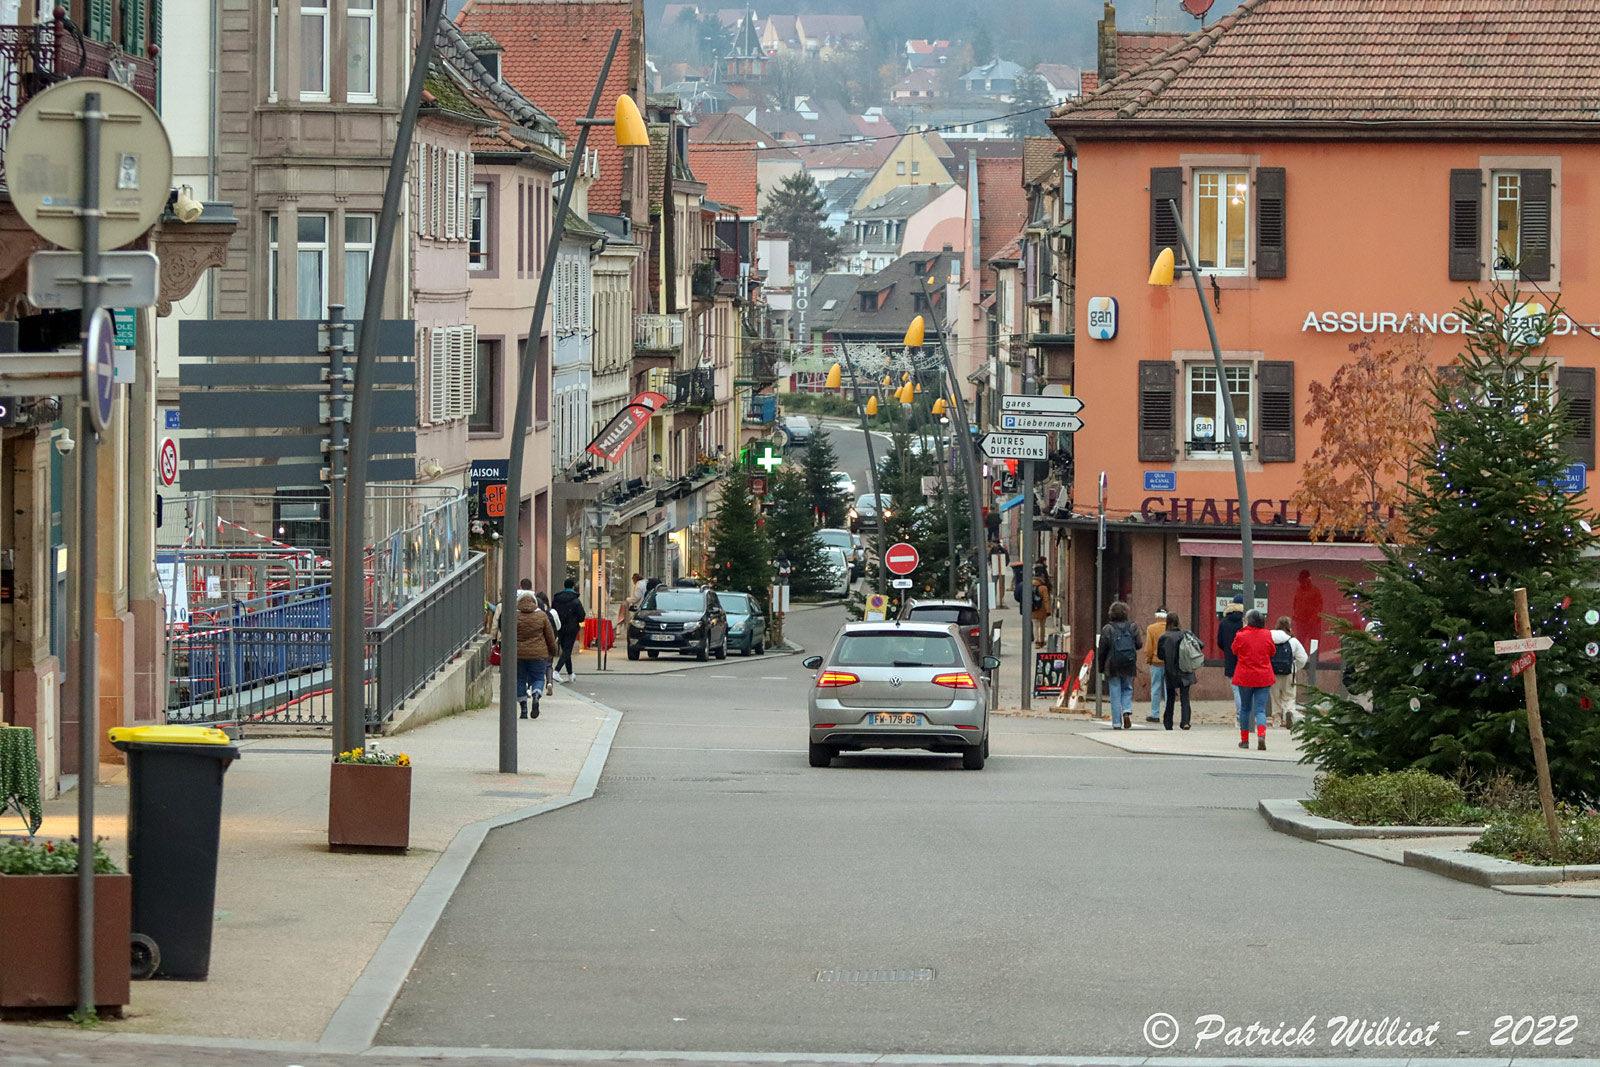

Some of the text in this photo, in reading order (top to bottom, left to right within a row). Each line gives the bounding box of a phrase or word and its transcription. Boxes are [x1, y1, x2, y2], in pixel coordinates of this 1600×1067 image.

[1090, 310, 1112, 327] gan
[1005, 401, 1031, 409] gares
[1007, 417, 1072, 428] P Liebermann
[1196, 423, 1212, 431] gan
[599, 416, 632, 450] MILLET
[991, 436, 1025, 446] AUTRES
[991, 446, 1044, 457] DIRECTIONS
